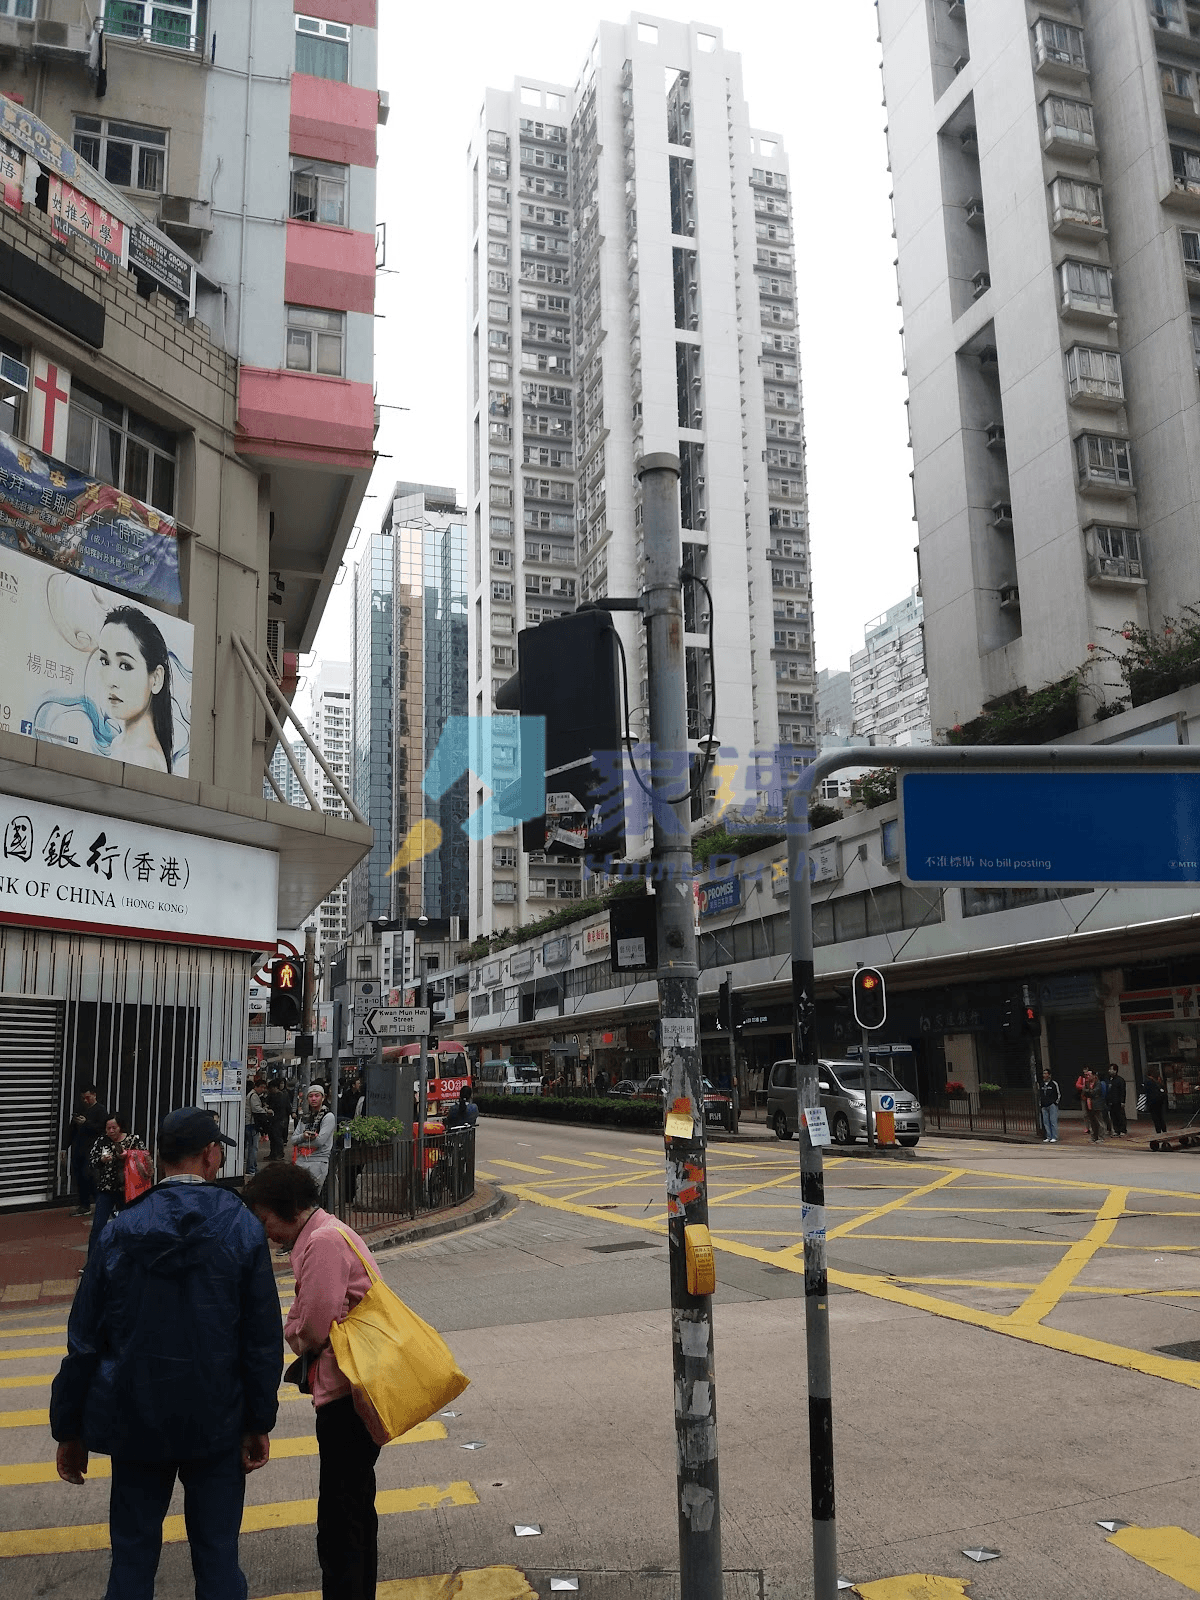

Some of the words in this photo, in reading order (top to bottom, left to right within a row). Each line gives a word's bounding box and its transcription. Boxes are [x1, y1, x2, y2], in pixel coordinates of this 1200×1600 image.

[40, 147, 63, 169] CITY
[139, 231, 168, 257] TREASURY
[168, 253, 188, 271] GROUP
[26, 652, 75, 685] 楊思琦
[924, 855, 975, 867] 不准標貼
[979, 858, 994, 868] No
[996, 858, 1012, 868] bill
[1013, 858, 1052, 870] posting
[0, 876, 19, 895] K
[25, 880, 51, 898] OF
[56, 884, 117, 908] CHINA
[121, 897, 155, 910] (HONG
[158, 901, 189, 915] KONG)
[708, 881, 734, 899] PROMISE
